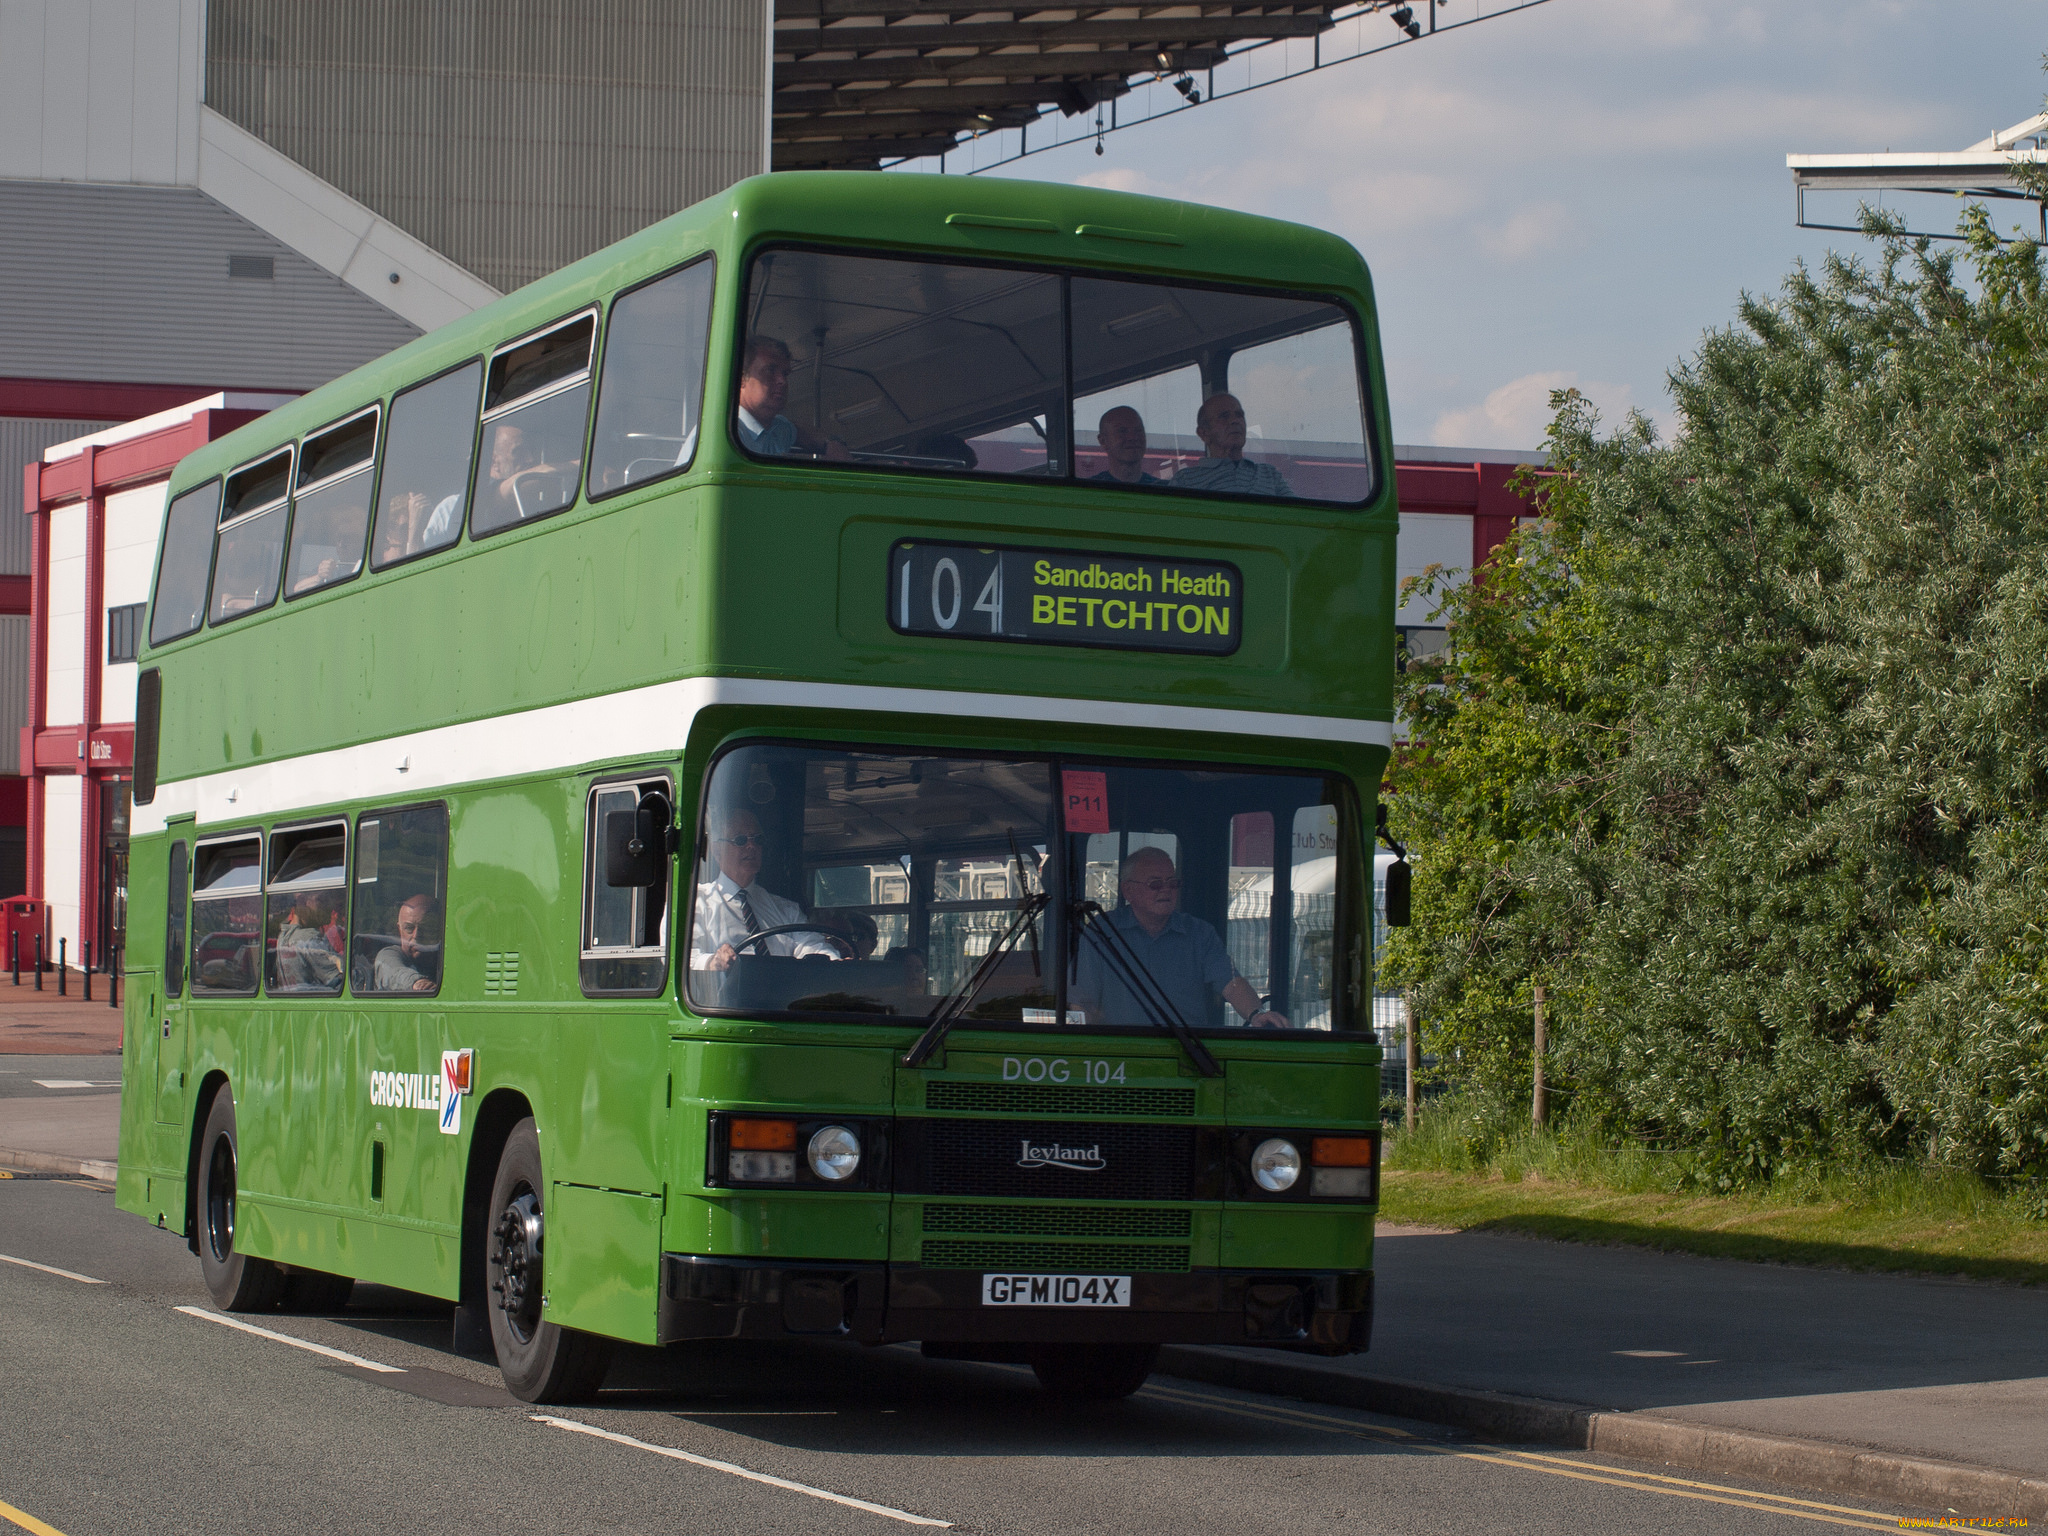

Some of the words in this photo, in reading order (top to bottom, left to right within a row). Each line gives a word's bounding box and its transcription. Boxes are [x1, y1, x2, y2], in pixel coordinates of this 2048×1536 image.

[901, 557, 1003, 634] 104
[1033, 560, 1152, 592] Sandbach
[1161, 568, 1231, 597] Heath
[1032, 595, 1230, 636] BETCHTON
[1068, 795, 1101, 812] P11
[1003, 1057, 1071, 1083] DOG
[1083, 1060, 1126, 1084] 104
[370, 1070, 440, 1110] CROSVILLE
[1017, 1140, 1106, 1170] Leyland
